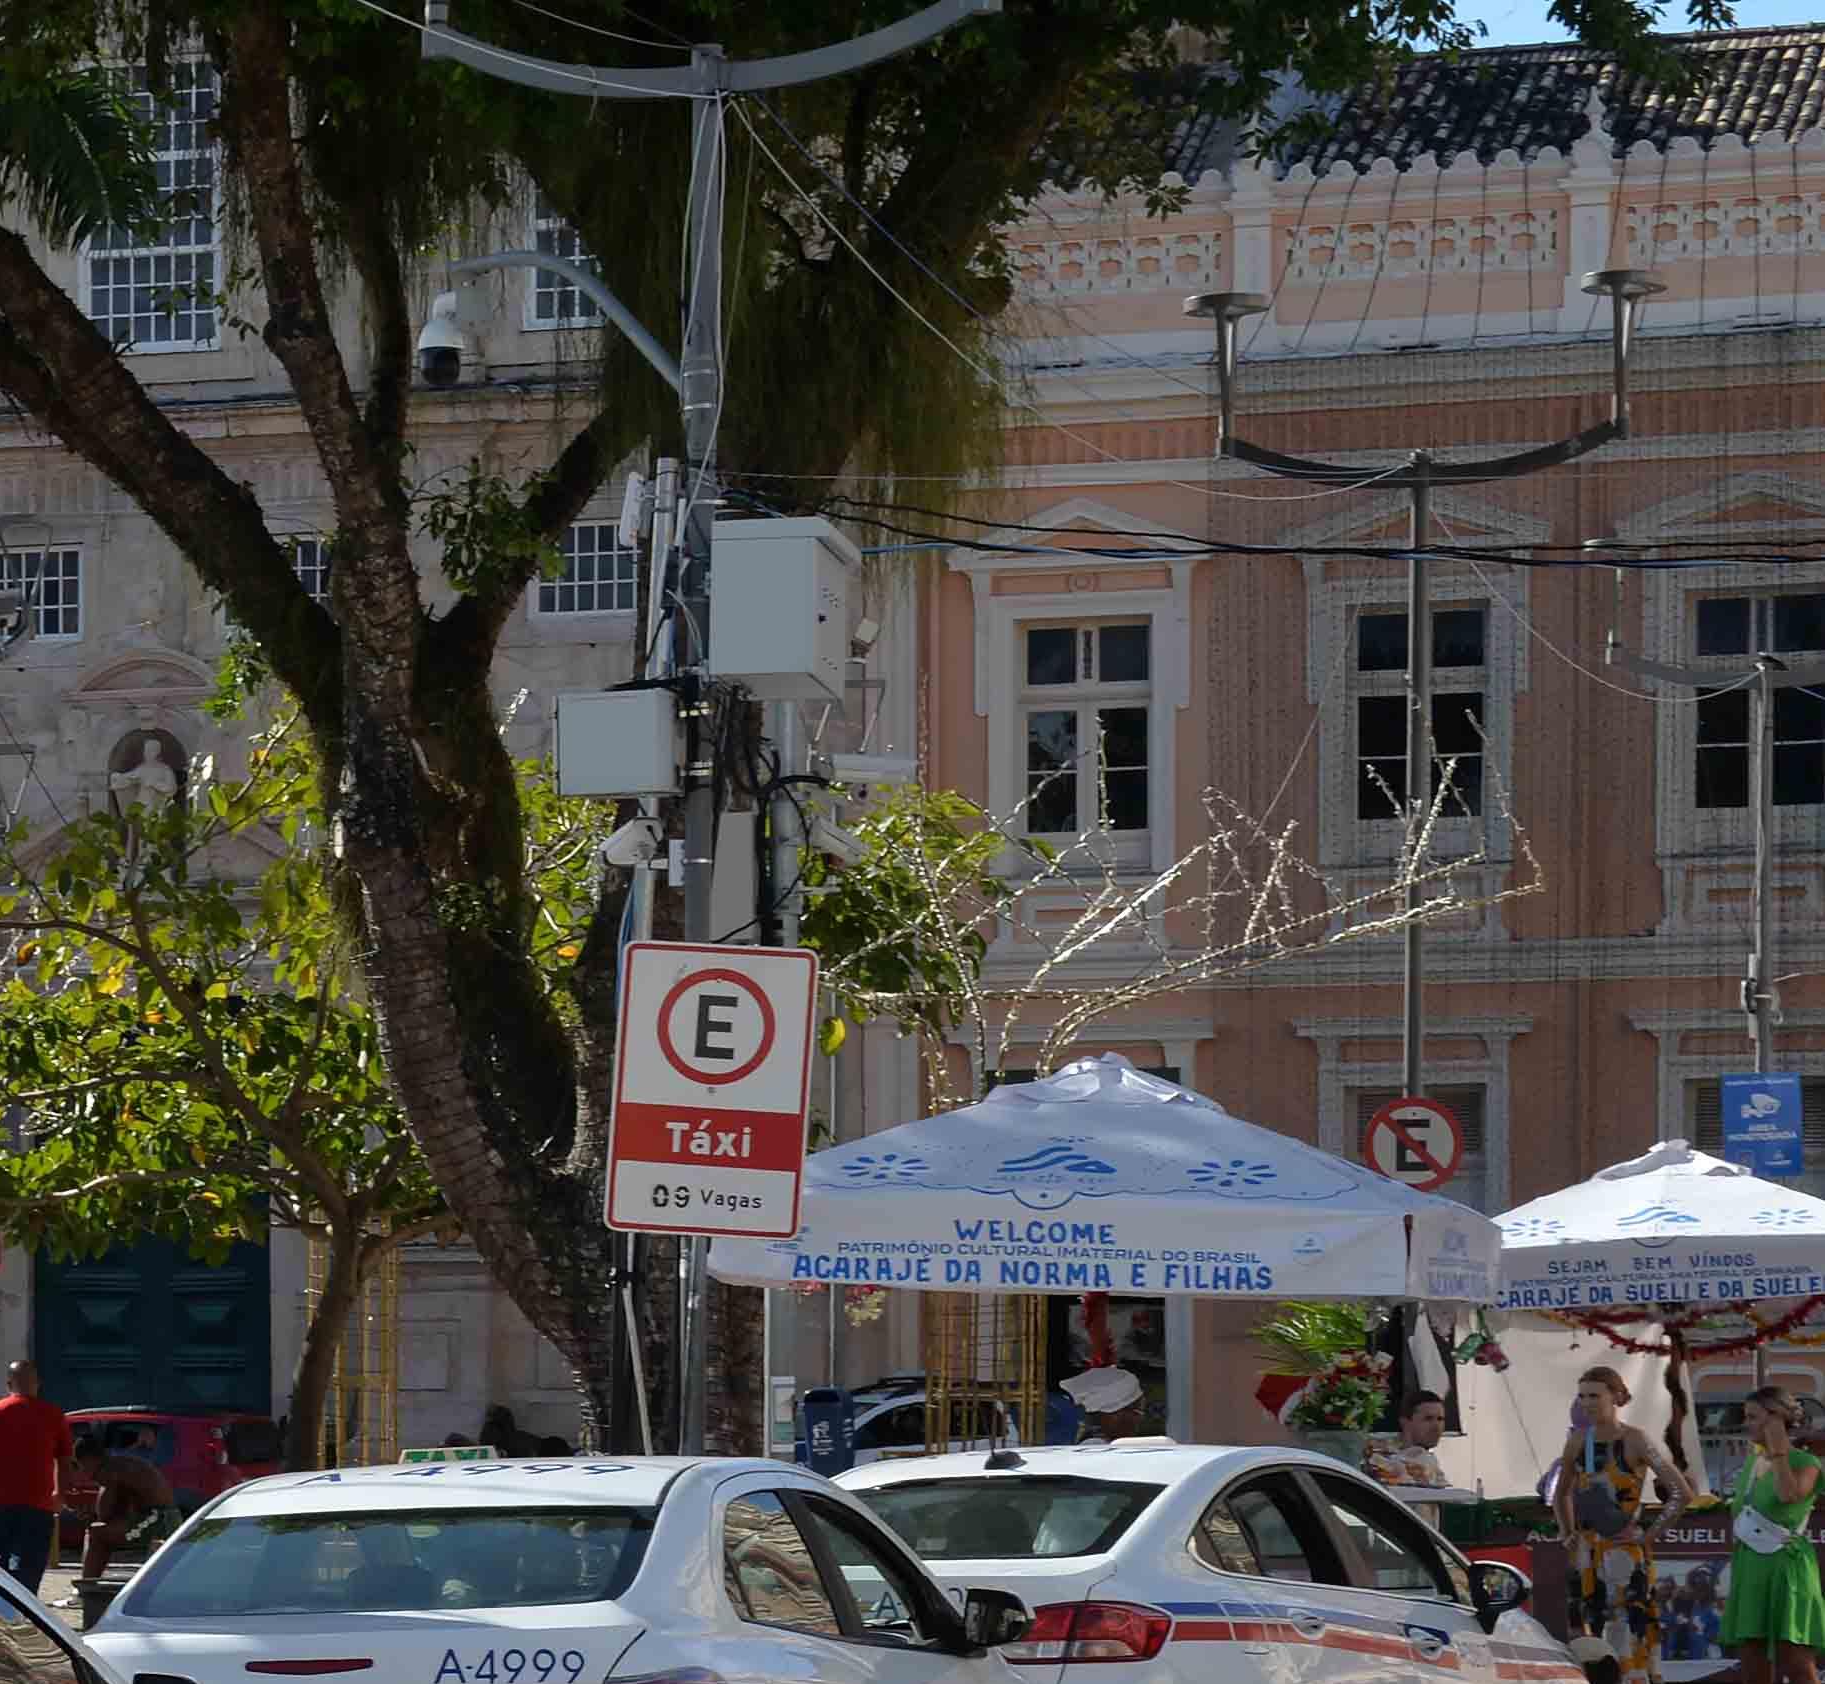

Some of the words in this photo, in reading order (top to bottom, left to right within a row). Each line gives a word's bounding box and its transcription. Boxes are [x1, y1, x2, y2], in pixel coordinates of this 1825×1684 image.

[695, 995, 738, 1059] E
[666, 1120, 751, 1157] Táxi
[653, 1184, 690, 1208] 09
[701, 1189, 762, 1211] Vagas
[954, 1219, 1117, 1245] WELCOME
[838, 1240, 952, 1255] PATRIMÔNIO
[957, 1243, 1053, 1257] CULTURAL
[1057, 1246, 1156, 1261] IMATERIAL
[1161, 1250, 1192, 1262] DO
[1194, 1251, 1261, 1264] BRASIL
[1549, 1260, 1608, 1274] SEJAM
[1633, 1256, 1671, 1270] BEM
[793, 1253, 931, 1282] ACARAJÉ
[945, 1259, 981, 1283] DA
[1000, 1260, 1112, 1287] NORMA
[1131, 1264, 1147, 1287] E
[1165, 1264, 1273, 1290] FILHAS
[1589, 1287, 1613, 1303] DA
[1626, 1282, 1690, 1301] SUELI
[1699, 1281, 1709, 1298] E
[1718, 1280, 1743, 1297] DA
[1664, 1529, 1725, 1543] SUELI
[434, 1649, 585, 1684] A-4999
